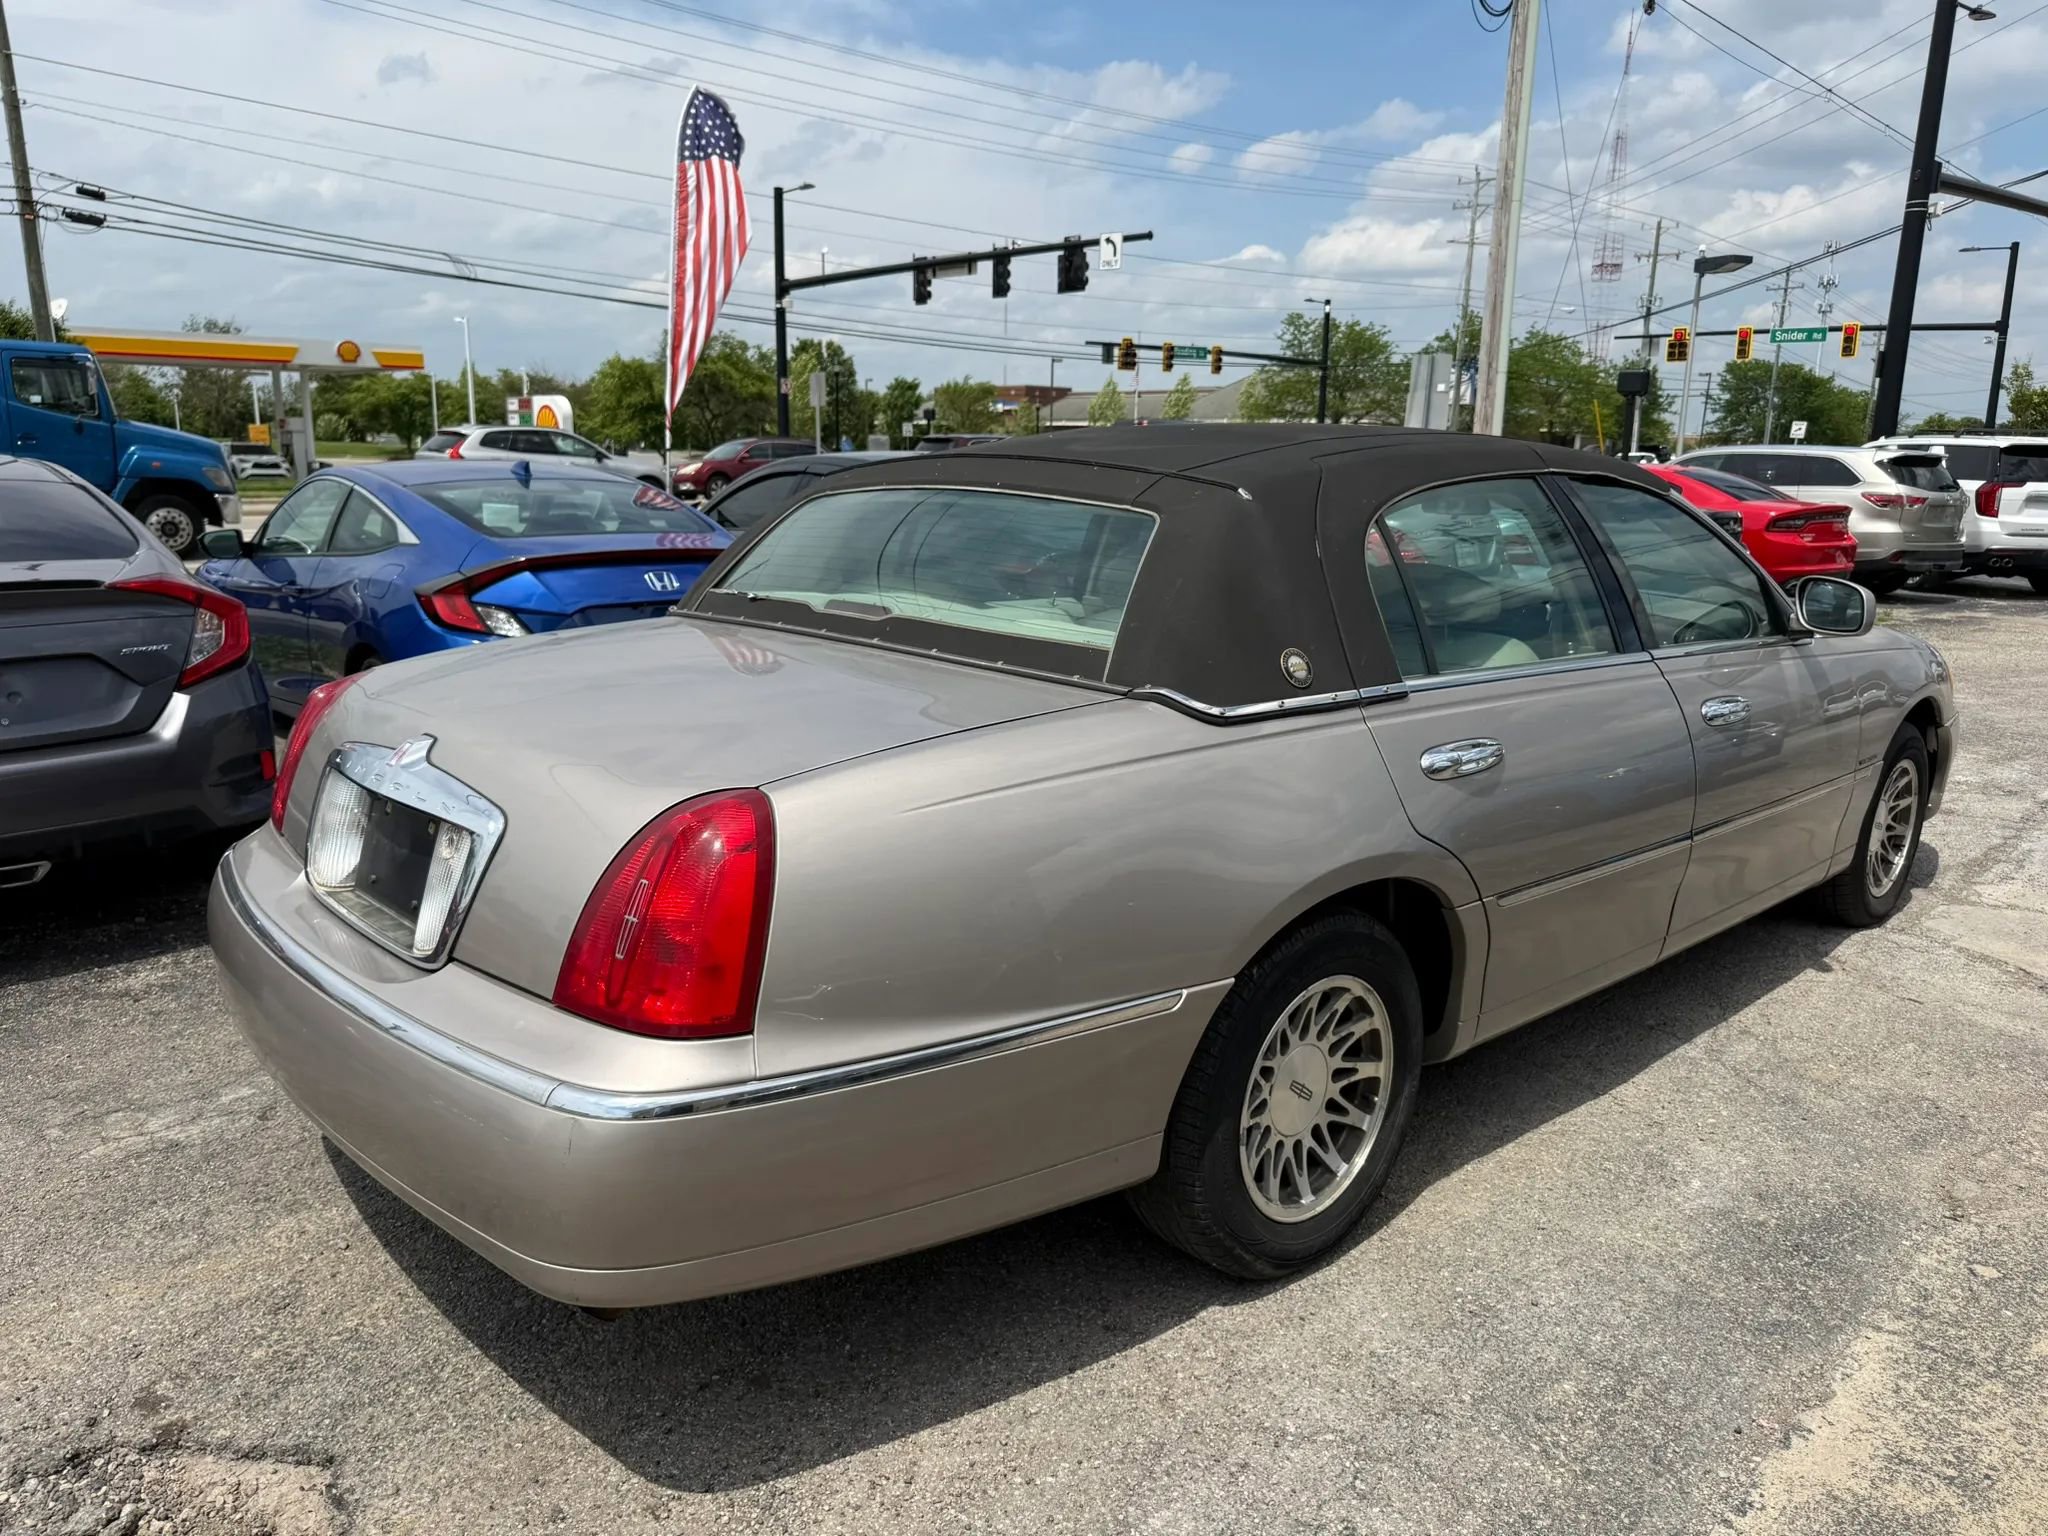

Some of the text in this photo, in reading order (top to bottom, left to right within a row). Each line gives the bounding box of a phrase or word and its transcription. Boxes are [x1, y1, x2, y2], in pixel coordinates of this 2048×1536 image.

[1102, 260, 1119, 268] ONLY
[1775, 331, 1823, 341] Snider Rd
[120, 644, 172, 656] SPORT
